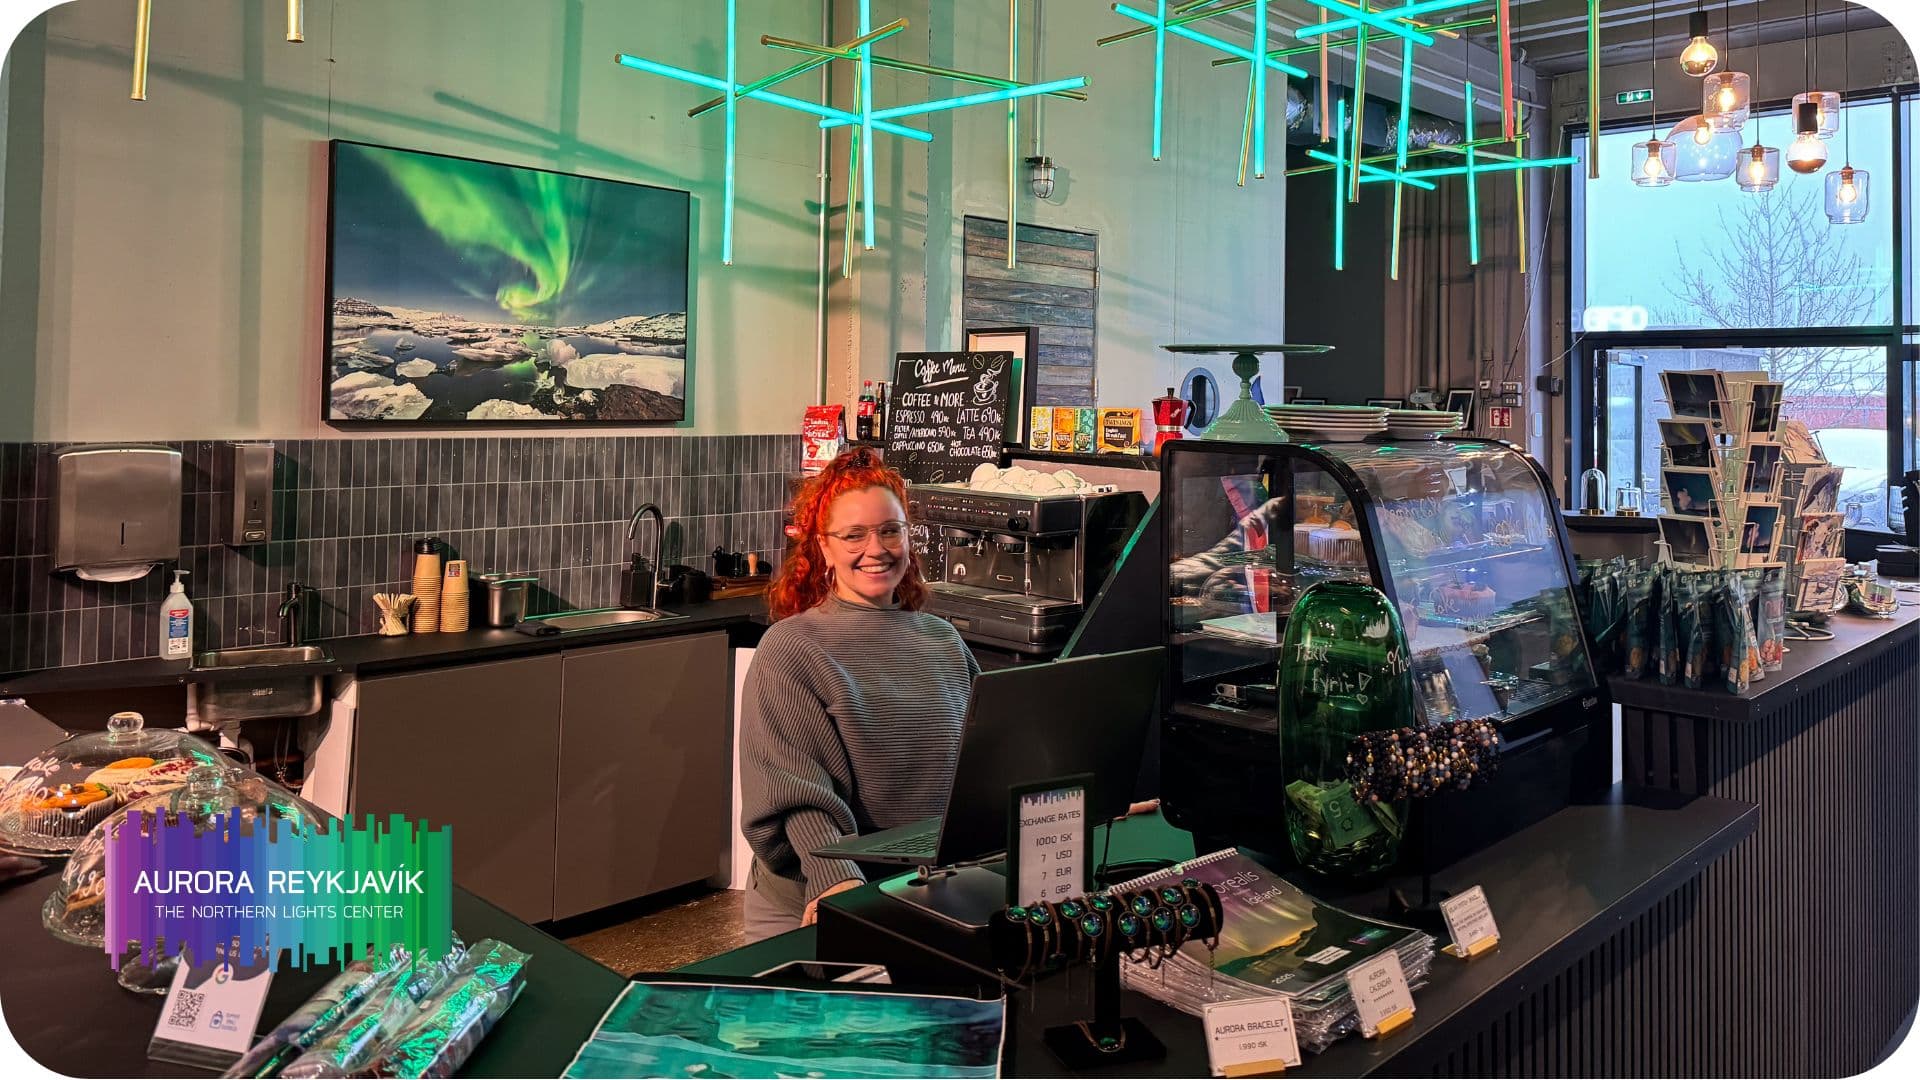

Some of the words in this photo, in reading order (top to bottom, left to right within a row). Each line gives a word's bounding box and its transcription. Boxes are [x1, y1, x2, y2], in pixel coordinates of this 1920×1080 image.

[914, 359, 941, 384] Coffee
[942, 357, 967, 376] Menu
[902, 392, 931, 407] COFFEE
[941, 391, 965, 407] MORE
[896, 410, 925, 423] ESPRESSO
[957, 408, 980, 424] LATTE
[963, 426, 976, 441] TEA
[892, 440, 926, 452] CAPPUCCINO
[949, 446, 981, 458] CHOCOLATE
[1058, 810, 1081, 821] RATES
[1036, 835, 1058, 847] 1000
[1060, 833, 1073, 843] ISK
[1041, 854, 1047, 863] 7
[1056, 849, 1073, 860] USD
[1042, 871, 1047, 880] 7
[1056, 867, 1072, 877] EUR
[1041, 889, 1047, 898] 6
[1056, 883, 1072, 894] GBP
[1215, 1024, 1246, 1035] AURORA
[1247, 1019, 1284, 1031] BRACELET
